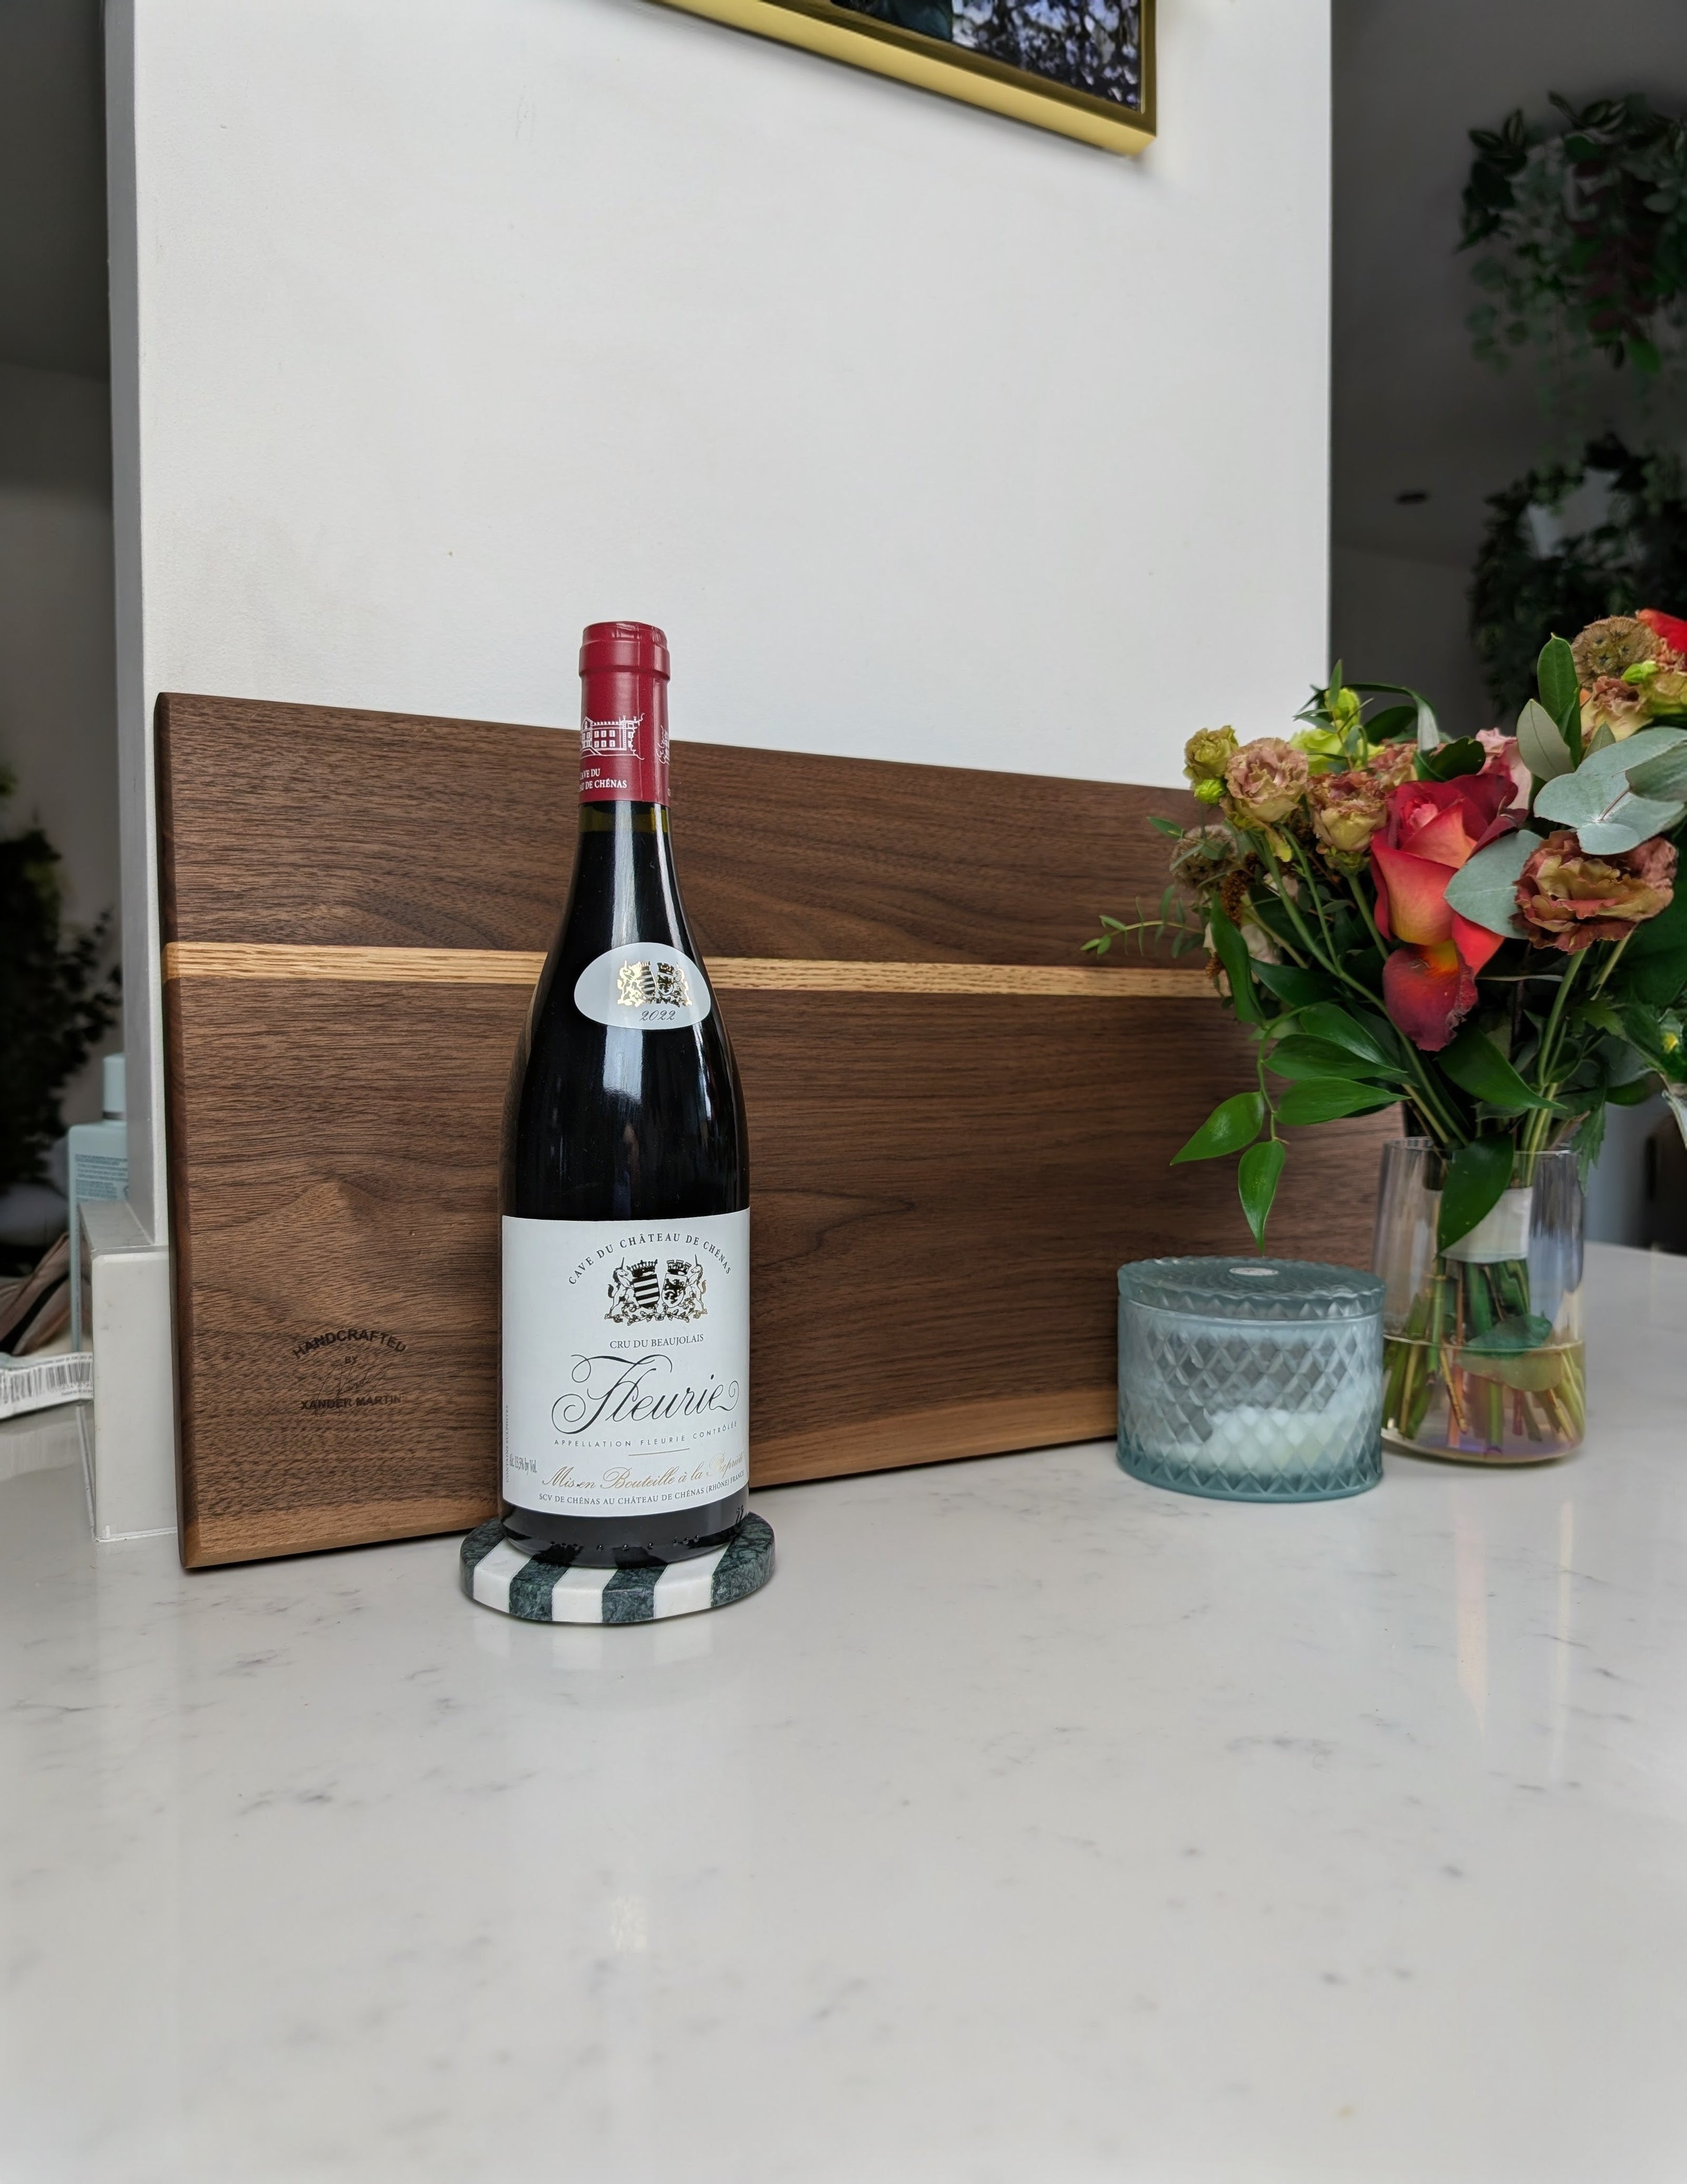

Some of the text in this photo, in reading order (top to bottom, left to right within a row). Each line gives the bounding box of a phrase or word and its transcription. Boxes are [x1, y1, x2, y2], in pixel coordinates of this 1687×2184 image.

[590, 768, 600, 777] DU
[585, 780, 593, 790] DE
[594, 778, 627, 788] CHÉNAS
[639, 1010, 676, 1021] 2022
[569, 1233, 731, 1284] CAVE DU CHÂTEAU DE CHÉNAS
[292, 1328, 407, 1360] HANDCRAFTED
[610, 1340, 631, 1349] CRU
[651, 1333, 704, 1346] BEAUJOLAIS
[344, 1355, 358, 1365] BY
[300, 1395, 402, 1410] XANDER MARTIN
[552, 1354, 740, 1435] Fleurie
[554, 1420, 738, 1447] APPELLATION FLEURIE CONTRÔLÉE
[525, 1457, 530, 1476] by
[529, 1460, 538, 1473] Vol.
[542, 1466, 575, 1487] Mis
[579, 1481, 596, 1489] en
[599, 1466, 680, 1490] Bouteille
[678, 1471, 688, 1483] à
[690, 1461, 704, 1481] la
[567, 1496, 600, 1505] CHÉNAS
[617, 1496, 658, 1504] CHÂTEAU
[674, 1487, 704, 1499] CHÉNAS
[705, 1479, 730, 1493] (RHÔNE)
[730, 1470, 745, 1484] FRANCE
